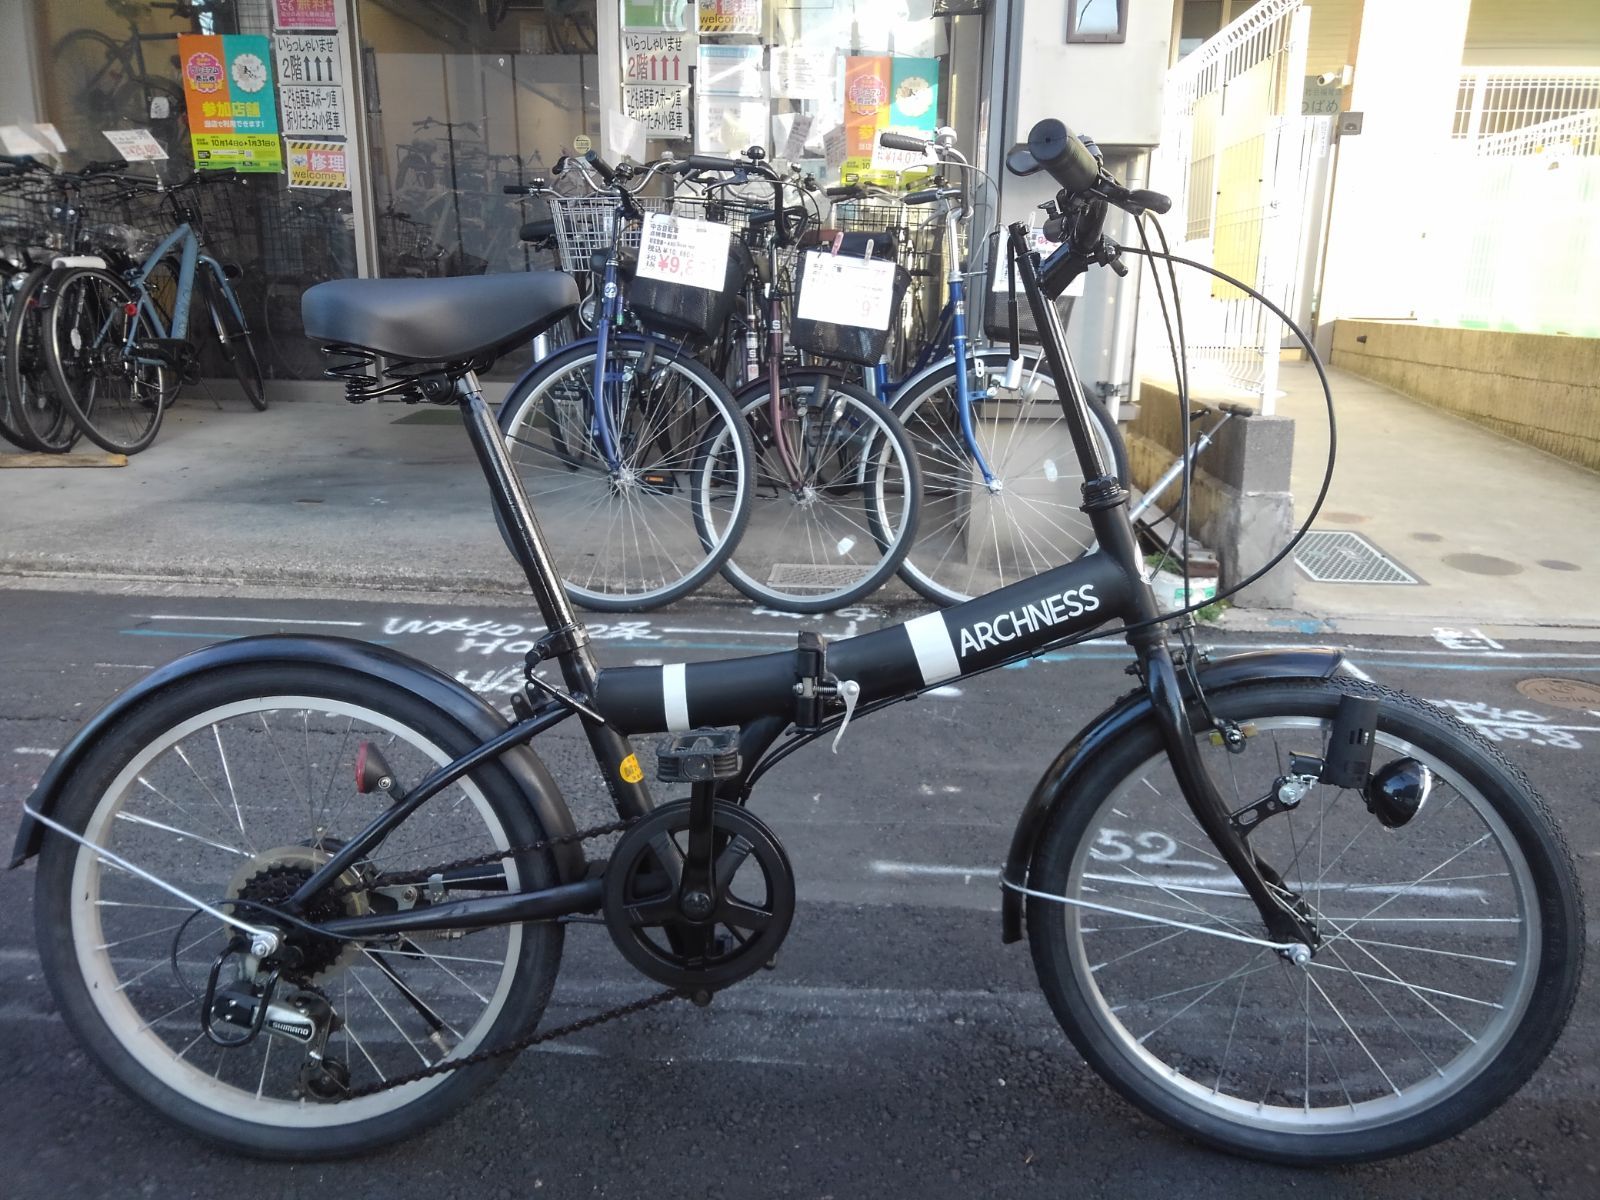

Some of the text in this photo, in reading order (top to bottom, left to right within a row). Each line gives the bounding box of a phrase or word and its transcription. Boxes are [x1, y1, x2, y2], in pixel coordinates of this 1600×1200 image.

[278, 37, 333, 52] いらっしゃいませ
[625, 36, 682, 52] いらっしゃいませ
[282, 54, 302, 80] 2階
[628, 53, 648, 80] 2階
[310, 152, 345, 172] 修理
[293, 170, 337, 180] welcome
[960, 584, 1100, 657] ARCHNESS
